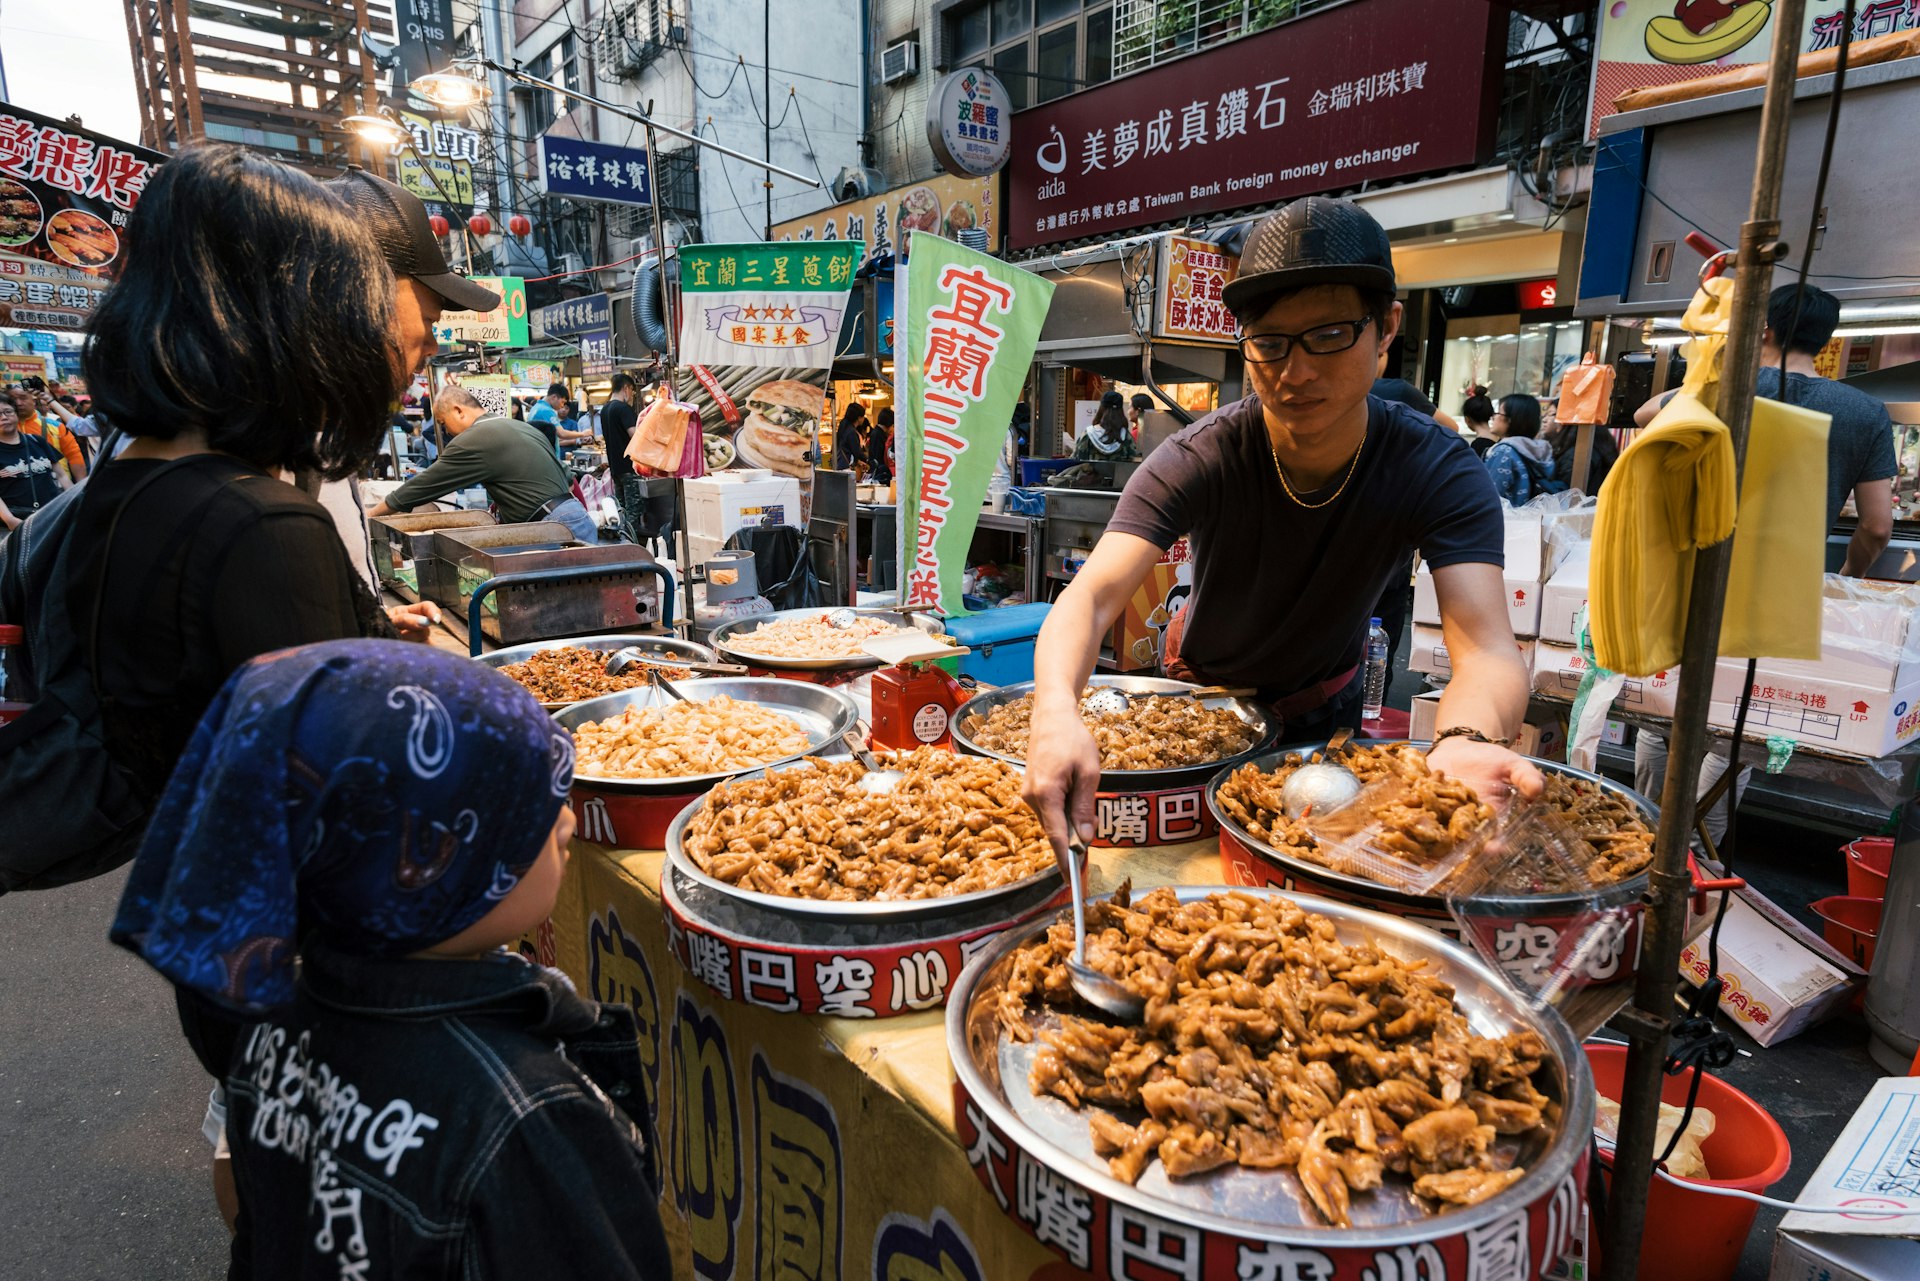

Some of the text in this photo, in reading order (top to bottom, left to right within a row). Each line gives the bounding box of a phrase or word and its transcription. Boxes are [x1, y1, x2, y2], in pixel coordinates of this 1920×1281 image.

[406, 22, 445, 41] ORIS
[1307, 61, 1428, 118] 金瑞利珠寶
[957, 99, 999, 128] 波羅蜜
[1081, 76, 1291, 175] 美夢成真鑽石
[957, 121, 999, 142] 免費書坊
[0, 114, 163, 211] 變態烤
[548, 152, 646, 192] 裕祥珠寶
[1144, 190, 1184, 208] Taiwan
[1190, 181, 1221, 199] Bank
[1226, 171, 1273, 192] foreign
[1280, 160, 1329, 180] money
[1334, 141, 1420, 170] exchanger
[1037, 176, 1066, 200] aida
[691, 254, 853, 287] 宜蘭三星蔥餅
[1190, 270, 1225, 302] 黃金
[1170, 299, 1237, 334] 酥炸冰魚
[731, 325, 811, 346] 國宴美食
[1816, 714, 1829, 723] 90
[1849, 713, 1868, 722] UP
[1098, 792, 1219, 844] 嘴巴
[663, 908, 996, 1018] 大嘴巴空心
